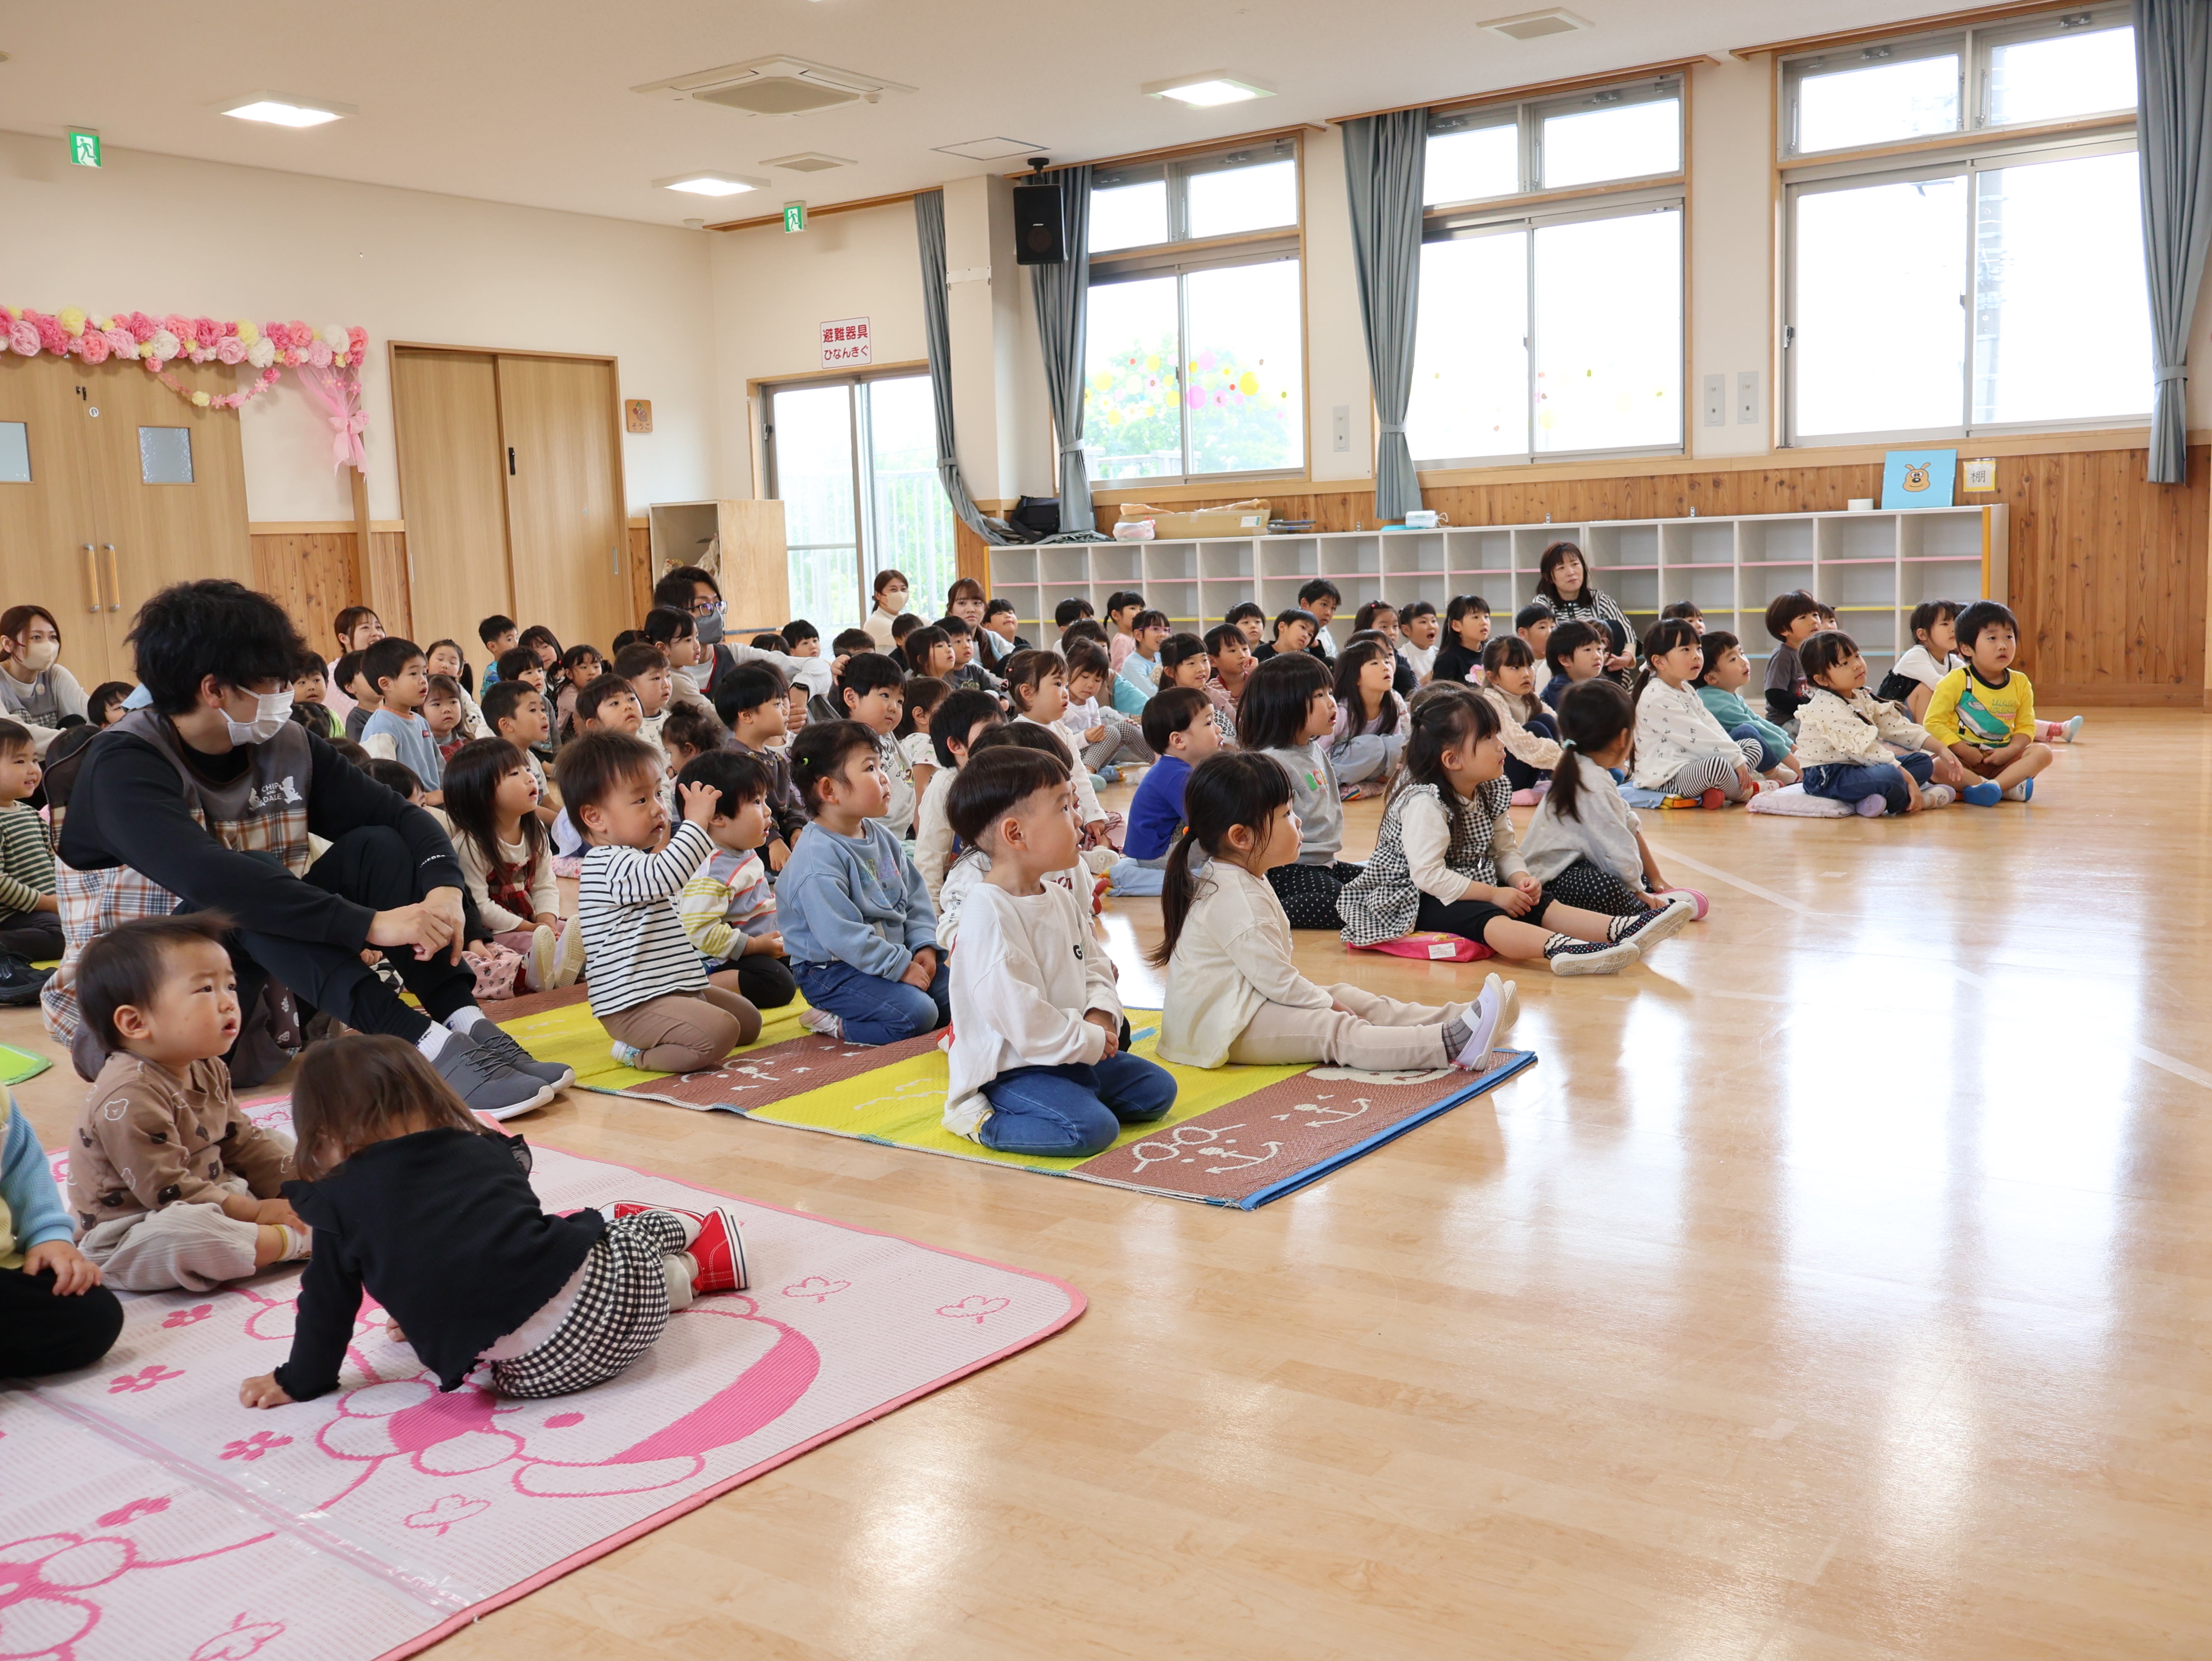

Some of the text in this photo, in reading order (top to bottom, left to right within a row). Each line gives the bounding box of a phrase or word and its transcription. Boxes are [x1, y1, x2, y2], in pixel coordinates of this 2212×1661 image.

[822, 324, 868, 343] 避難器具
[824, 345, 869, 360] ひなんきぐ
[1970, 470, 1986, 483] 棚
[262, 782, 279, 792] CHIP
[262, 793, 282, 803] DALE
[1073, 942, 1084, 960] G
